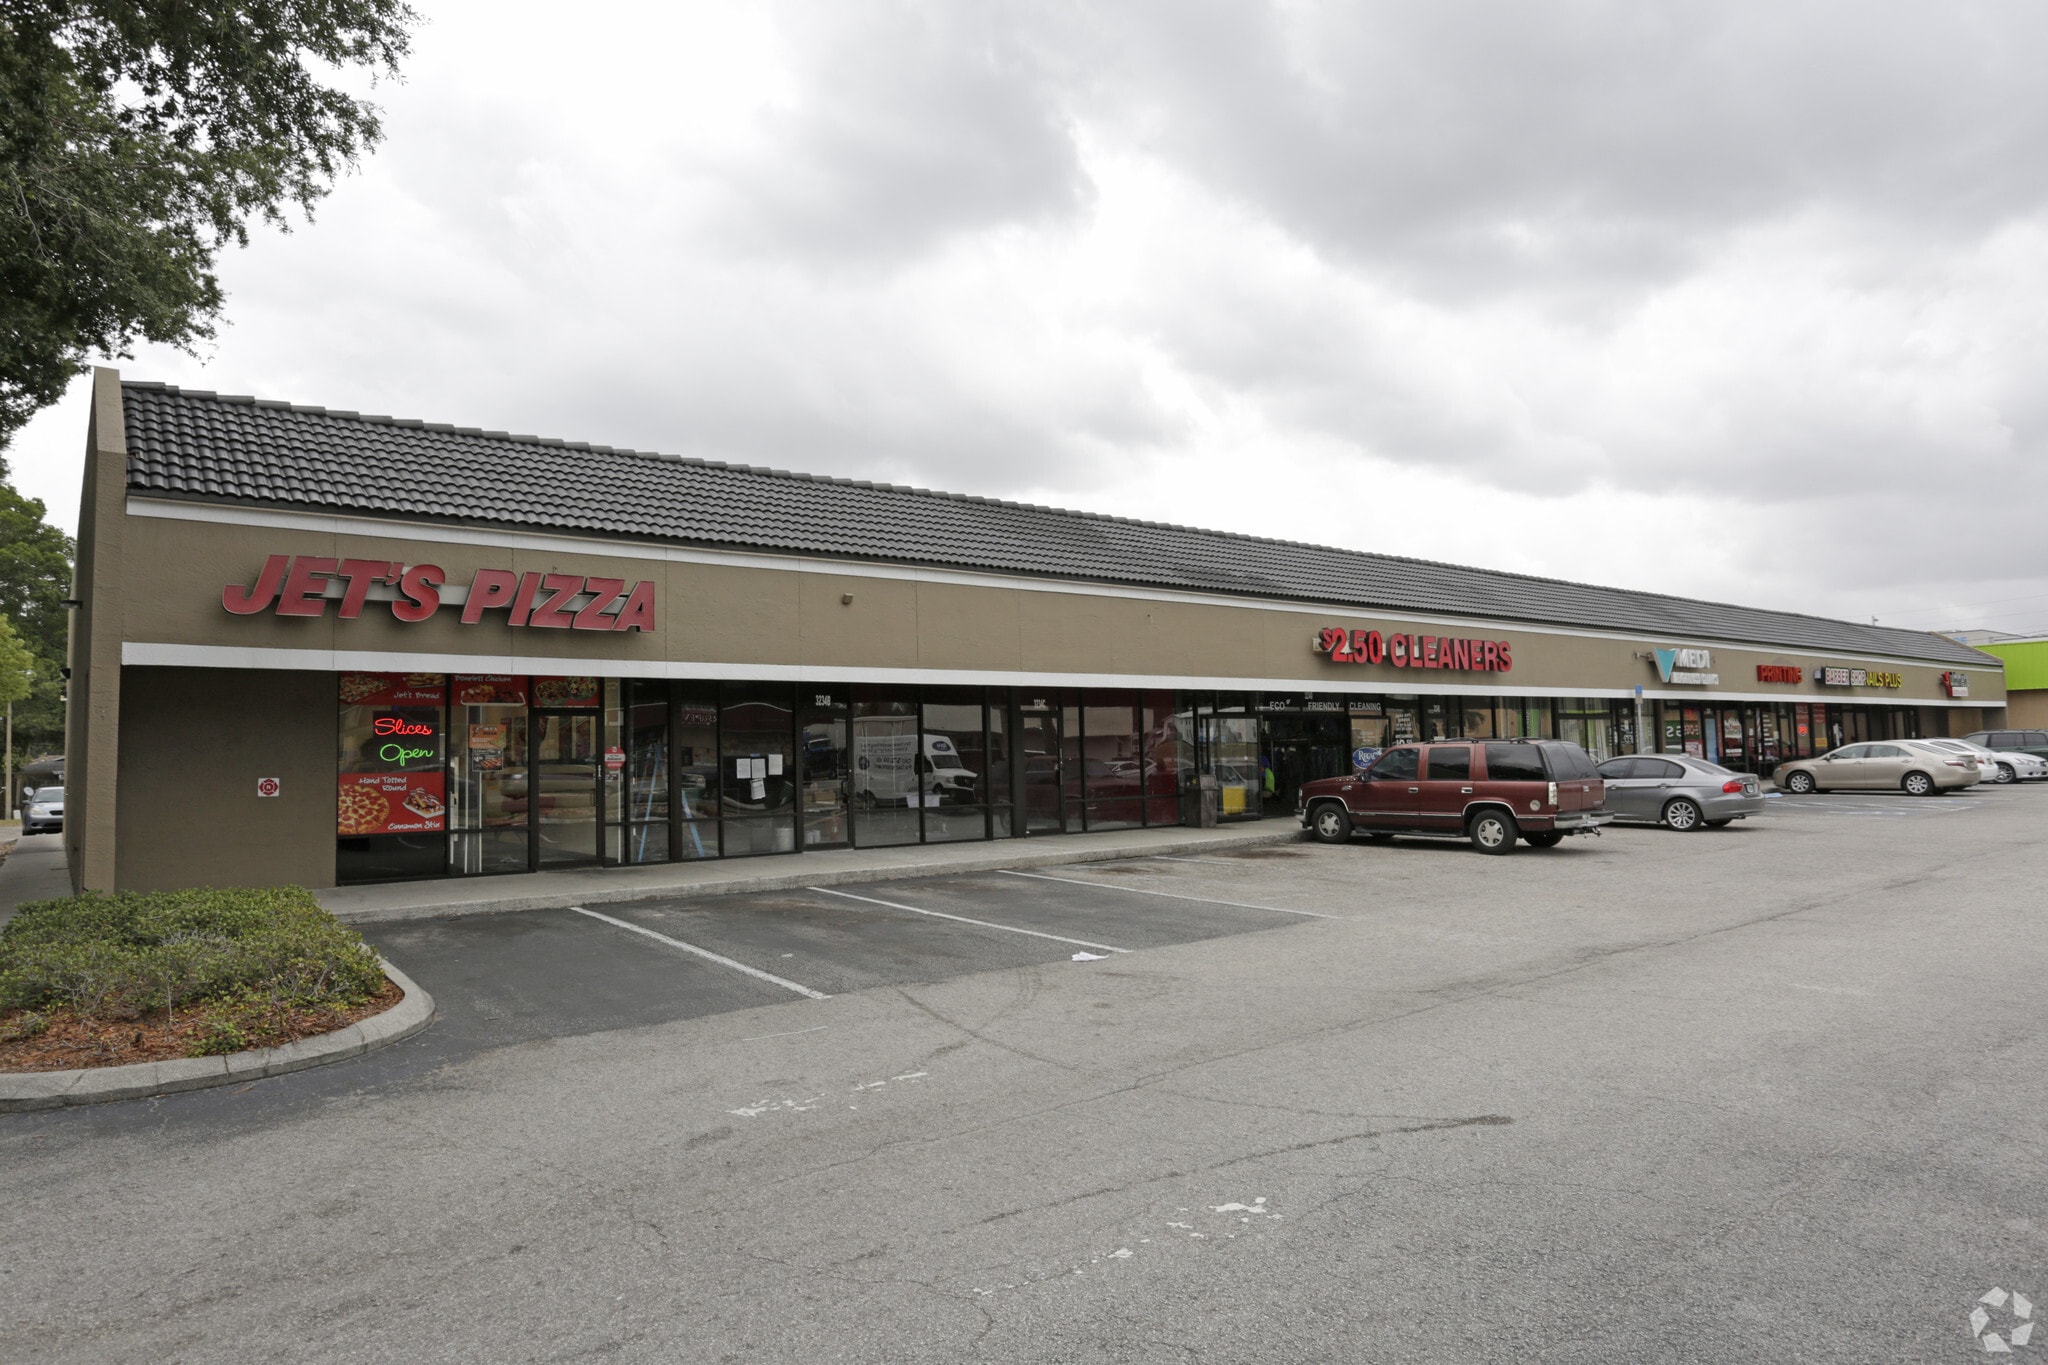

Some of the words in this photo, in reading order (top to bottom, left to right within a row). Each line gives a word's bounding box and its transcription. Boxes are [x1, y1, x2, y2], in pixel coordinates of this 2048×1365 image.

[222, 555, 446, 622] JET'S
[460, 568, 655, 632] PIZZA
[1320, 627, 1383, 664] $2.50
[1389, 632, 1513, 672] CLEANERS
[1676, 648, 1711, 669] MEDI
[1757, 665, 1803, 684] PRINTING
[1825, 667, 1849, 685] BARBER
[1850, 669, 1866, 686] SHOP
[1885, 672, 1902, 688] PLUS
[1269, 701, 1286, 710] ECO
[1307, 701, 1340, 710] FRIENDLY
[1349, 702, 1381, 711] CLEANING
[374, 717, 432, 736] Slices
[379, 743, 434, 767] Open
